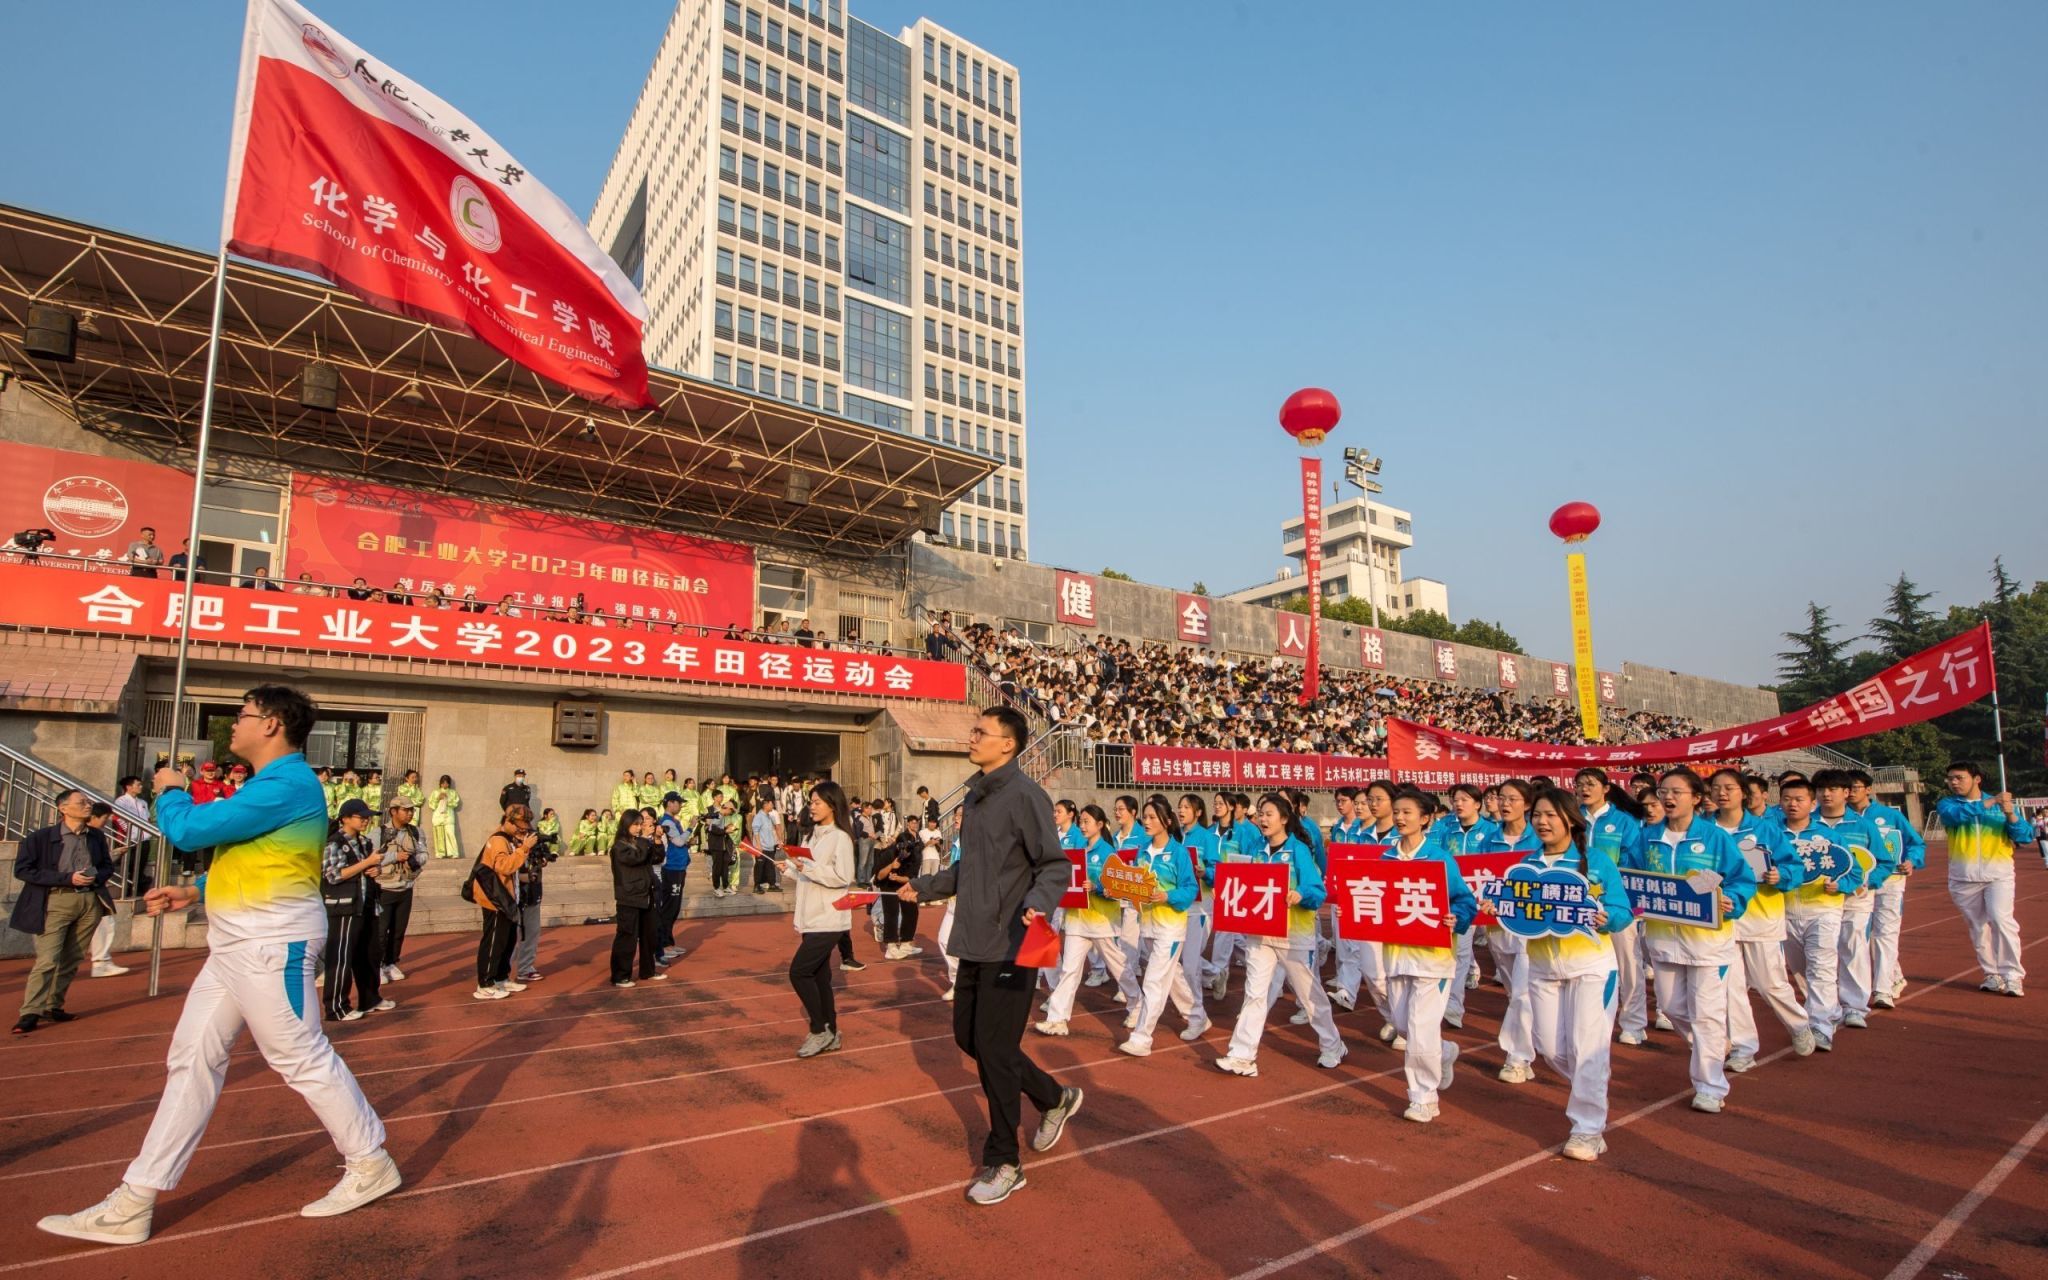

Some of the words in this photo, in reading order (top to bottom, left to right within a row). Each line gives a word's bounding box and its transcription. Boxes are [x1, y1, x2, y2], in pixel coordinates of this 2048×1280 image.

[302, 212, 357, 250] School
[361, 244, 381, 258] of
[381, 247, 454, 287] Chemistry
[457, 285, 481, 306] and
[483, 304, 545, 346] Chemical
[308, 175, 615, 358] 化学与化工学院
[357, 531, 710, 594] 合肥工业大学2023年田径运动会
[614, 602, 678, 621] 强国有为
[78, 584, 916, 690] 合肥工业大学2023年田径运动会
[1060, 577, 1095, 620] 健
[1182, 600, 1208, 637] 全
[1282, 618, 1305, 651] 人
[1362, 632, 1383, 665] 格
[1436, 645, 1456, 675] 锤
[1499, 656, 1517, 685] 炼
[1554, 666, 1569, 693] 意
[1601, 675, 1615, 700] 志
[1140, 757, 1231, 778] 食品与生物工程学院
[1242, 761, 1316, 782] 机械工程学院
[1324, 767, 1391, 782] 土木与水利工程学院
[1220, 876, 1282, 922] 化才
[1345, 875, 1441, 929] 育英
[1636, 894, 1701, 918] 未来可期
